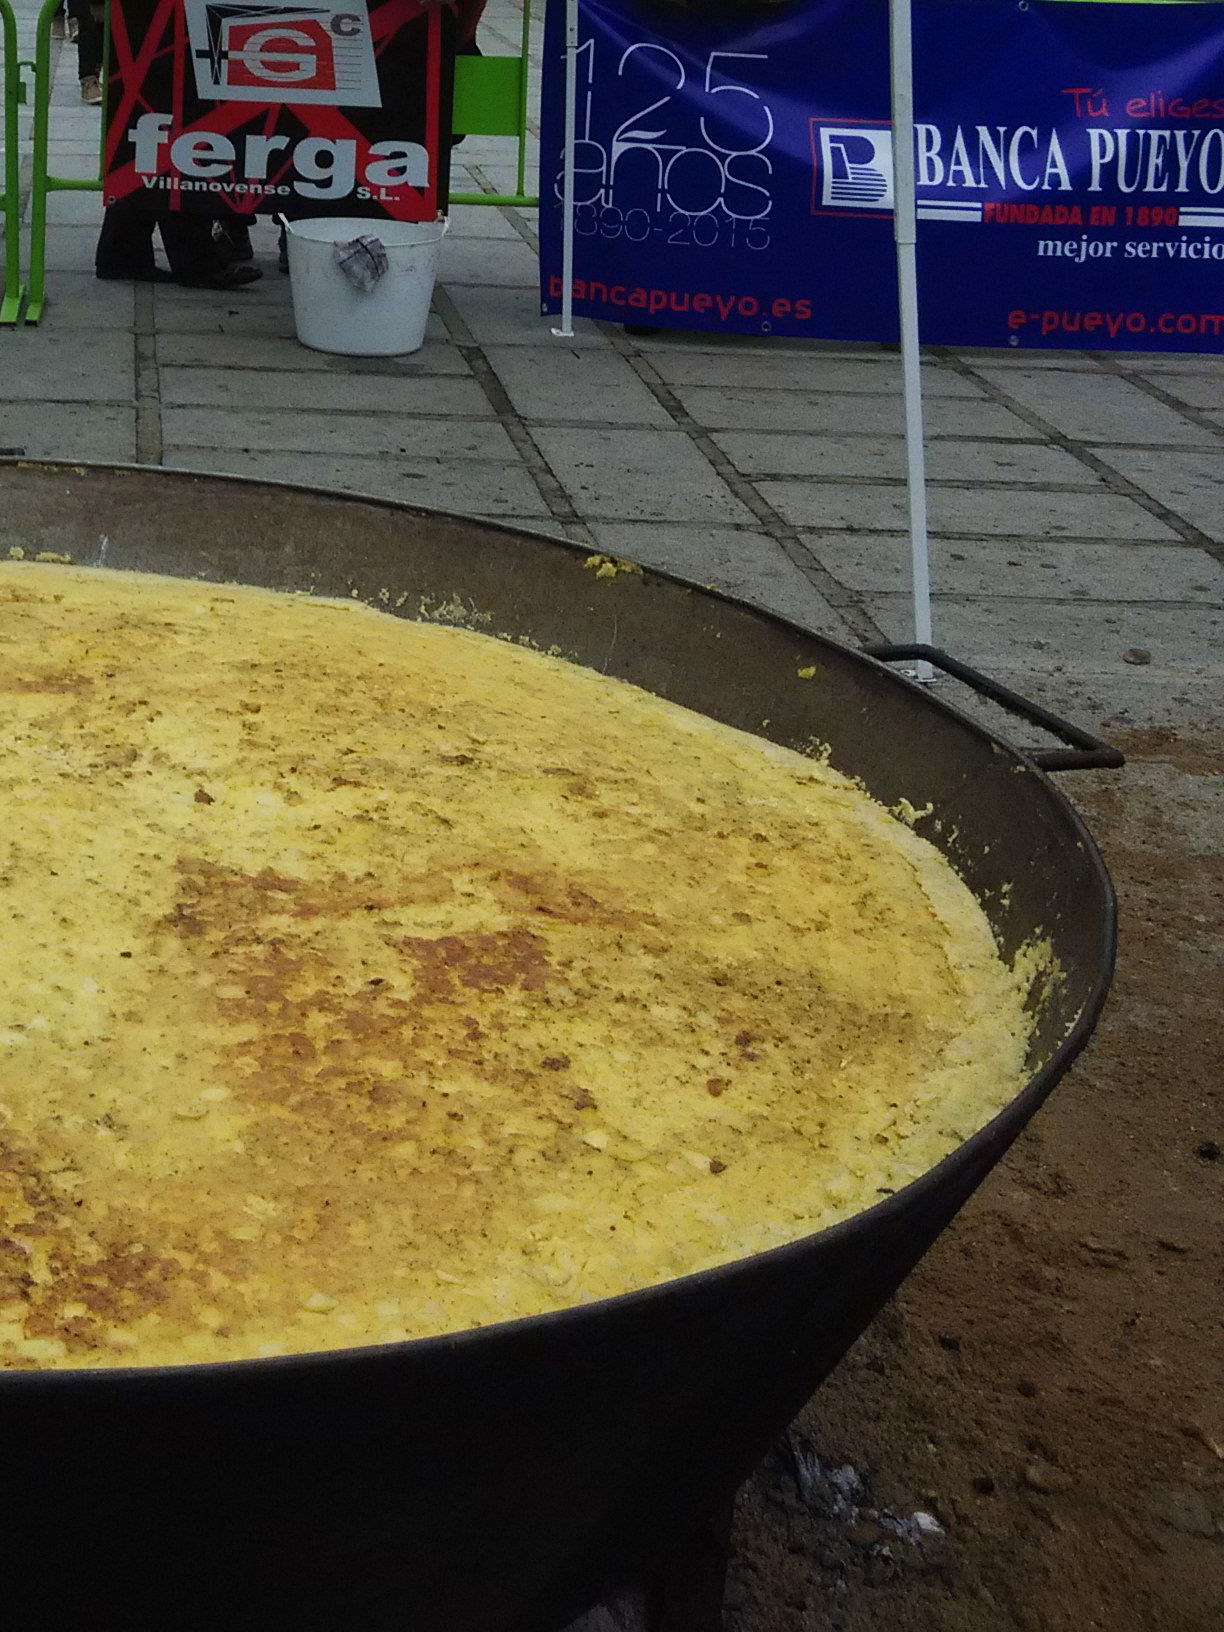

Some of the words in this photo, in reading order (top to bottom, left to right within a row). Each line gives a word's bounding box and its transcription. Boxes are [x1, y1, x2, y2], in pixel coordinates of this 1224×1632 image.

[1061, 87, 1110, 119] Tú
[128, 112, 430, 200] ferga
[914, 123, 1073, 192] BANCA
[1086, 128, 1224, 195] PUEYO
[141, 175, 291, 197] Villanovense
[356, 185, 400, 201] S.L.
[983, 201, 1082, 226] FUNDADA
[1090, 205, 1117, 227] EN
[1126, 206, 1179, 228] 1890
[1037, 234, 1118, 263] mejor
[1124, 235, 1224, 261] servicio
[549, 273, 813, 321] bancapueyo.es
[1007, 309, 1224, 338] e-pueyo.com
